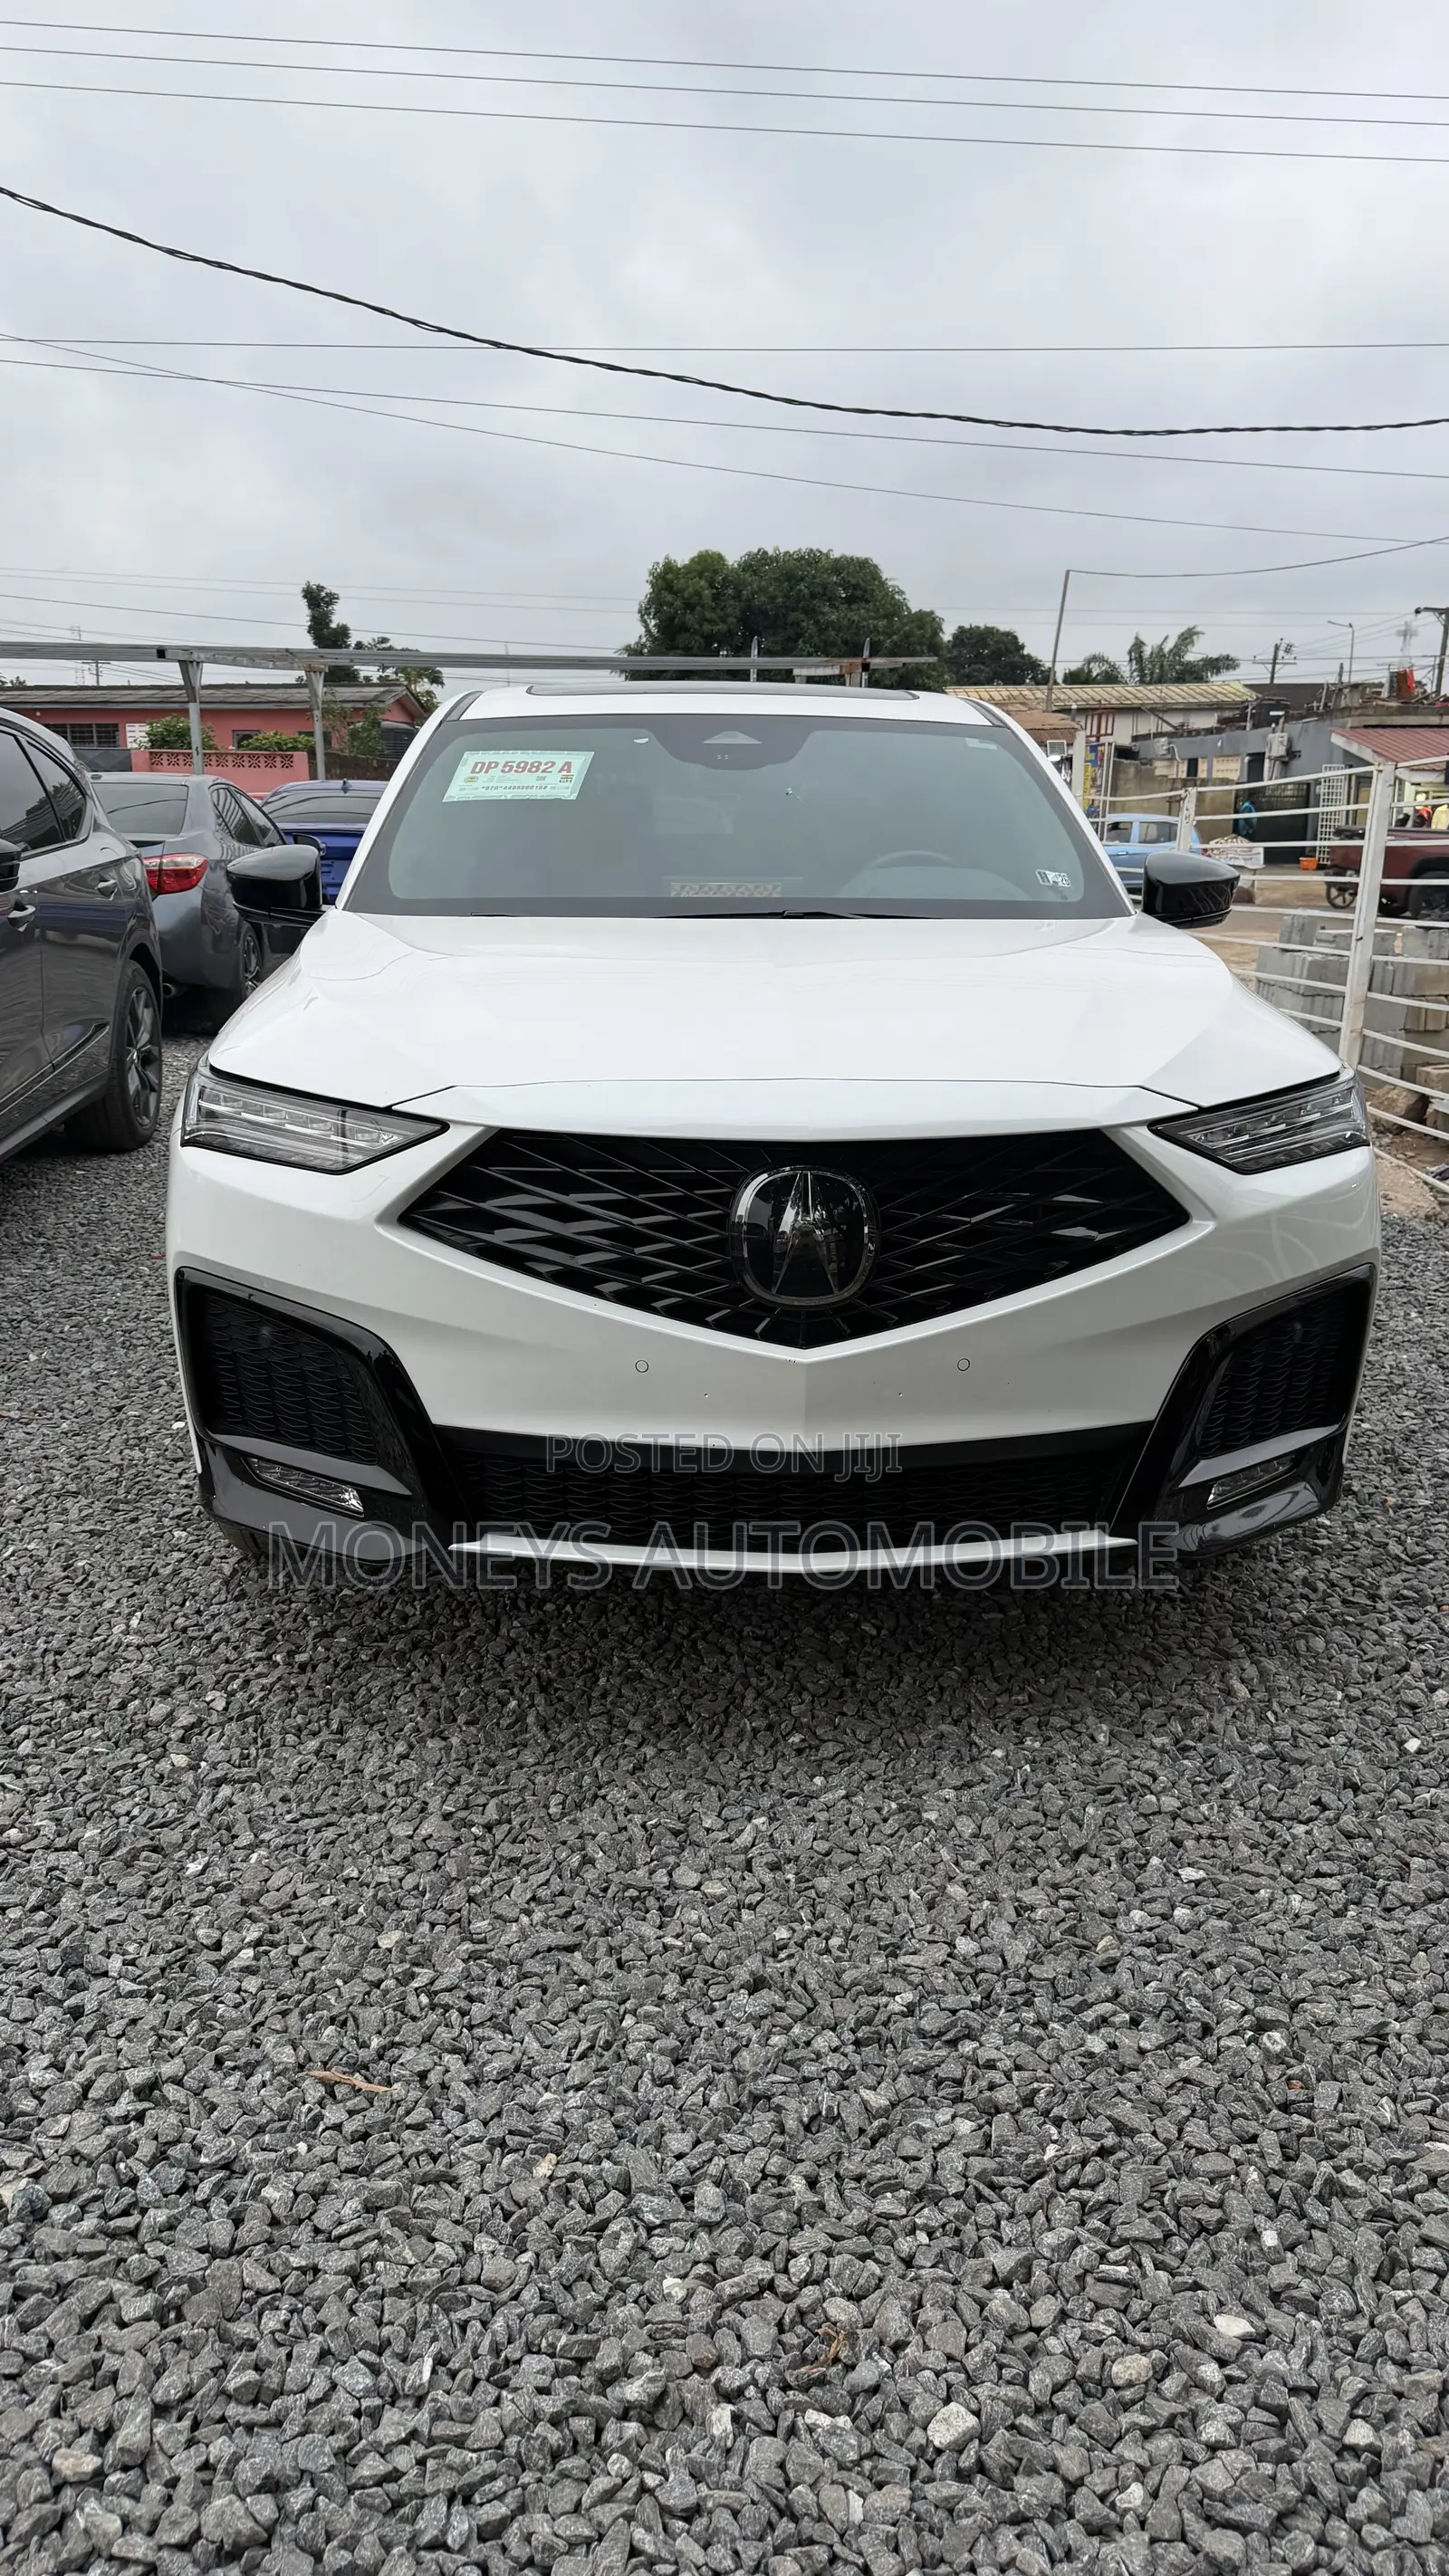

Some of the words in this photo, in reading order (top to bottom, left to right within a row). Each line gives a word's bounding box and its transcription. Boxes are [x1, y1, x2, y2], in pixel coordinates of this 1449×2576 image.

[470, 761, 499, 774] DP
[500, 761, 557, 774] 5982
[558, 761, 572, 774] A
